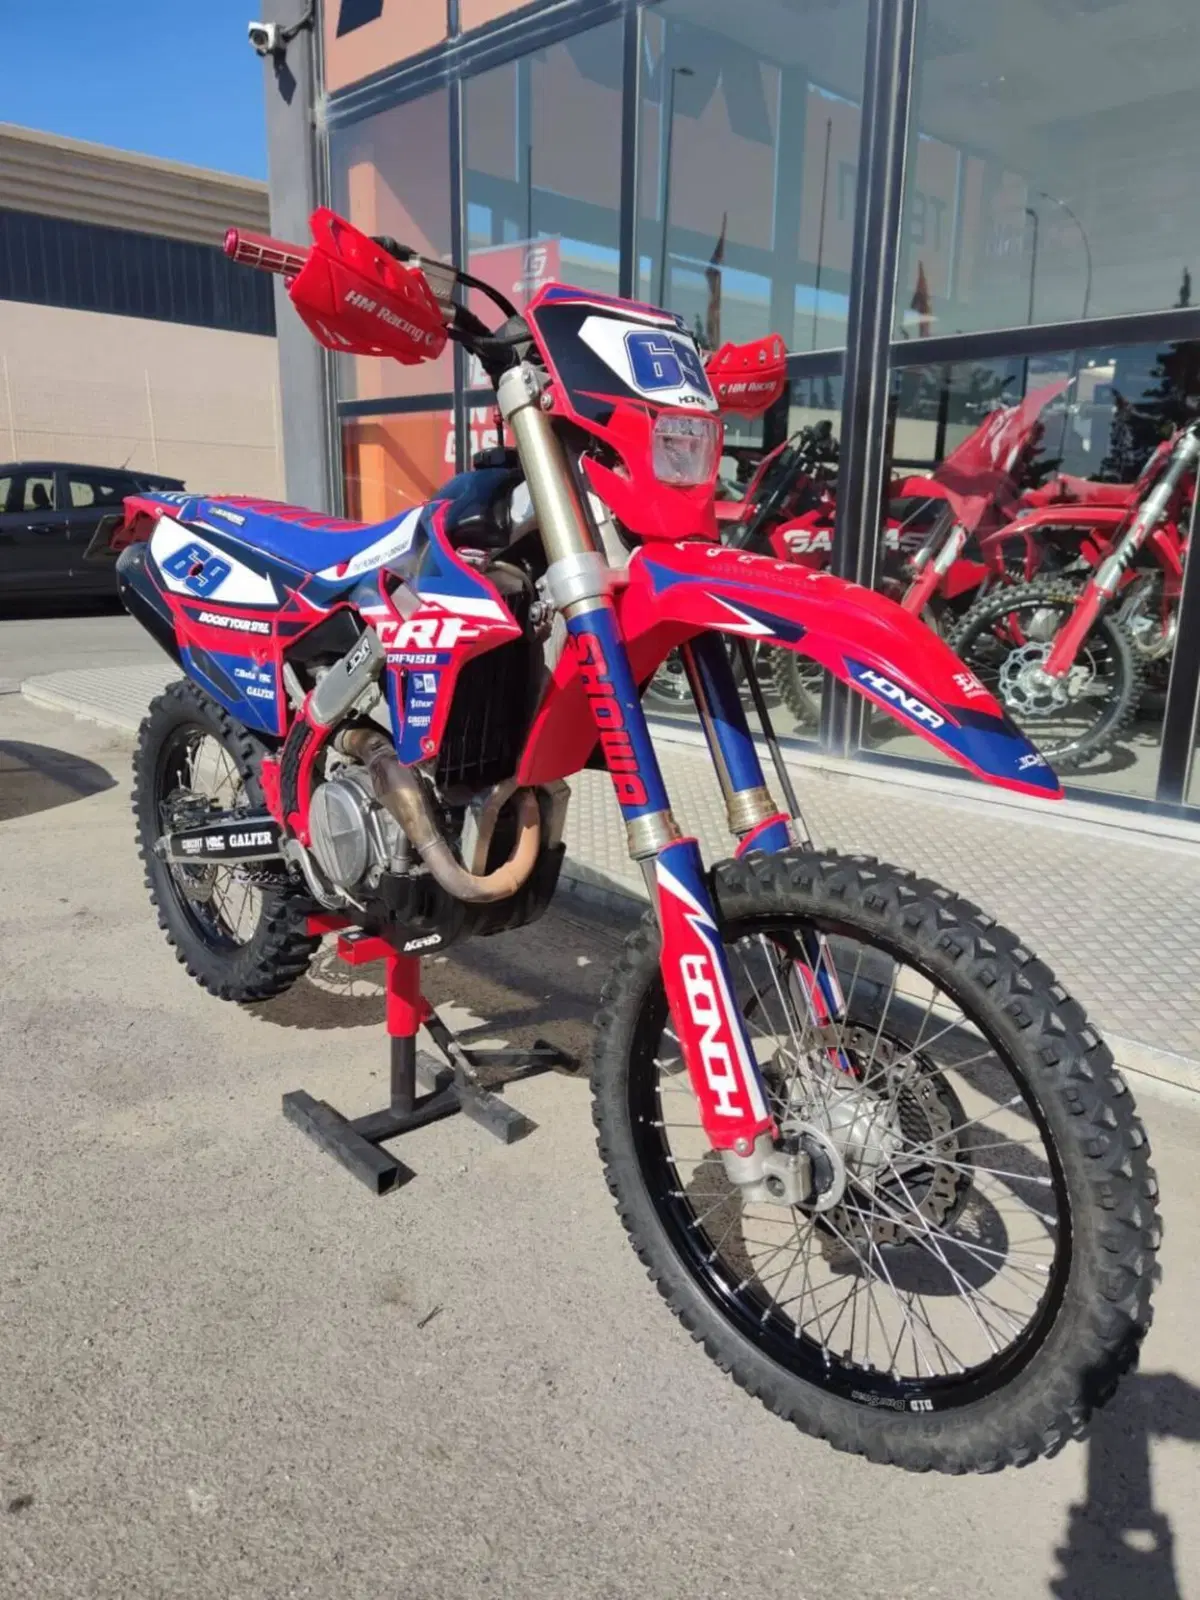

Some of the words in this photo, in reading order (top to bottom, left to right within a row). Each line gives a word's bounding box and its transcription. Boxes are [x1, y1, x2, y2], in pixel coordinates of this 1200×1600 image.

[344, 290, 377, 313] HM
[376, 307, 426, 343] Racing
[623, 330, 712, 398] 69
[727, 382, 747, 393] HM
[748, 380, 777, 392] Racing
[161, 542, 233, 598] 69
[376, 618, 481, 648] CRF
[387, 653, 437, 664] CRF450
[859, 670, 945, 729] HONDA
[229, 831, 273, 848] GALFER
[679, 953, 744, 1118] HONDA
